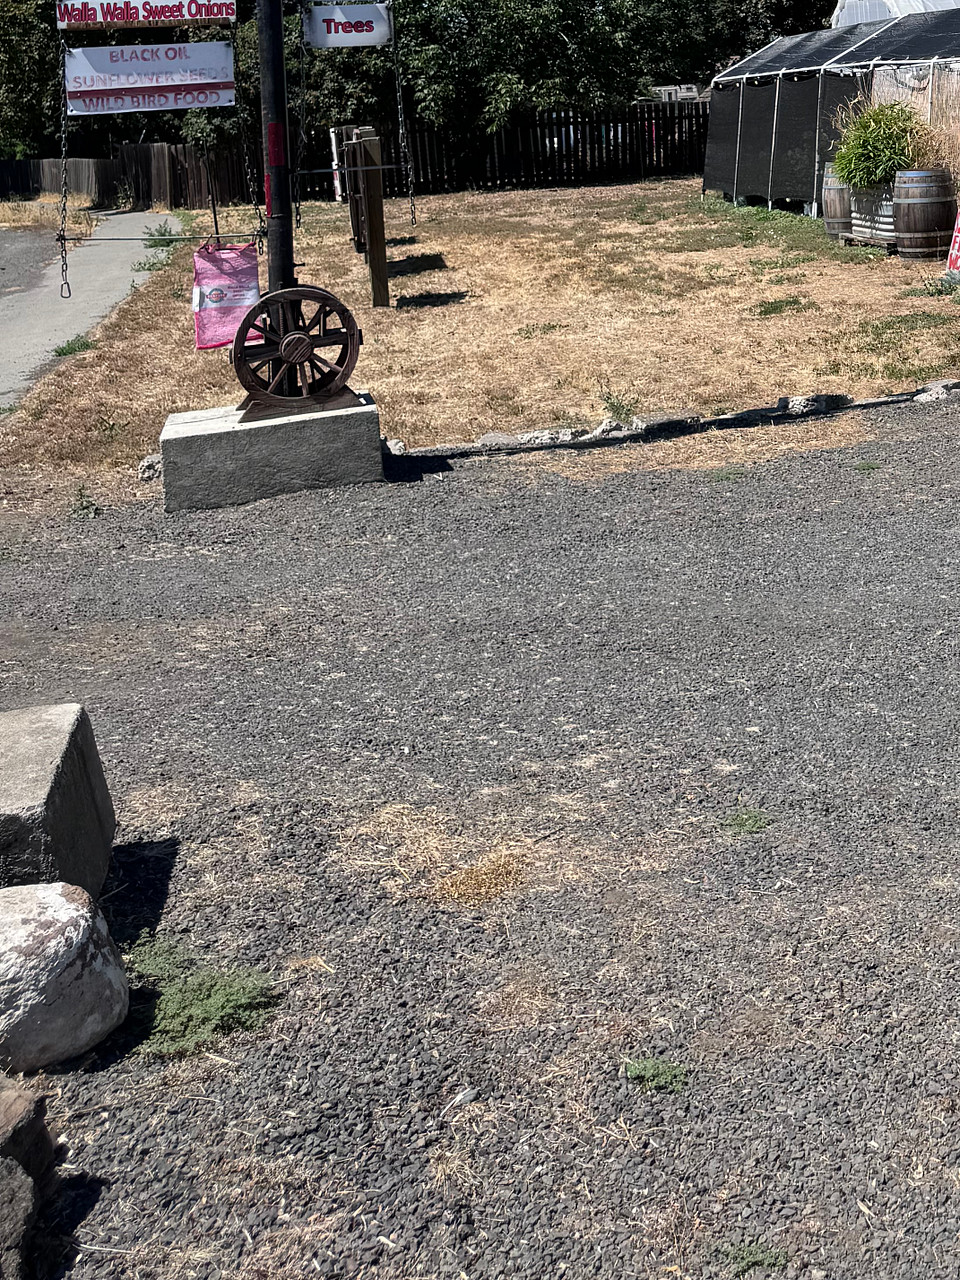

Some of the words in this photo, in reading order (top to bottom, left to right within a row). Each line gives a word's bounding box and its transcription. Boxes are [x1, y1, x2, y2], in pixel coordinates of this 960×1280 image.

[57, 1, 97, 22] Walla
[100, 0, 139, 21] Walla
[142, 0, 185, 20] Sweet
[322, 19, 374, 34] Trees
[109, 48, 160, 63] BLACK
[165, 46, 190, 60] OIL
[72, 72, 176, 89] SUNFLOWER
[179, 66, 229, 82] SEEDS
[82, 96, 125, 111] WILD
[131, 94, 169, 108] BIRD
[174, 91, 220, 105] FOOD
